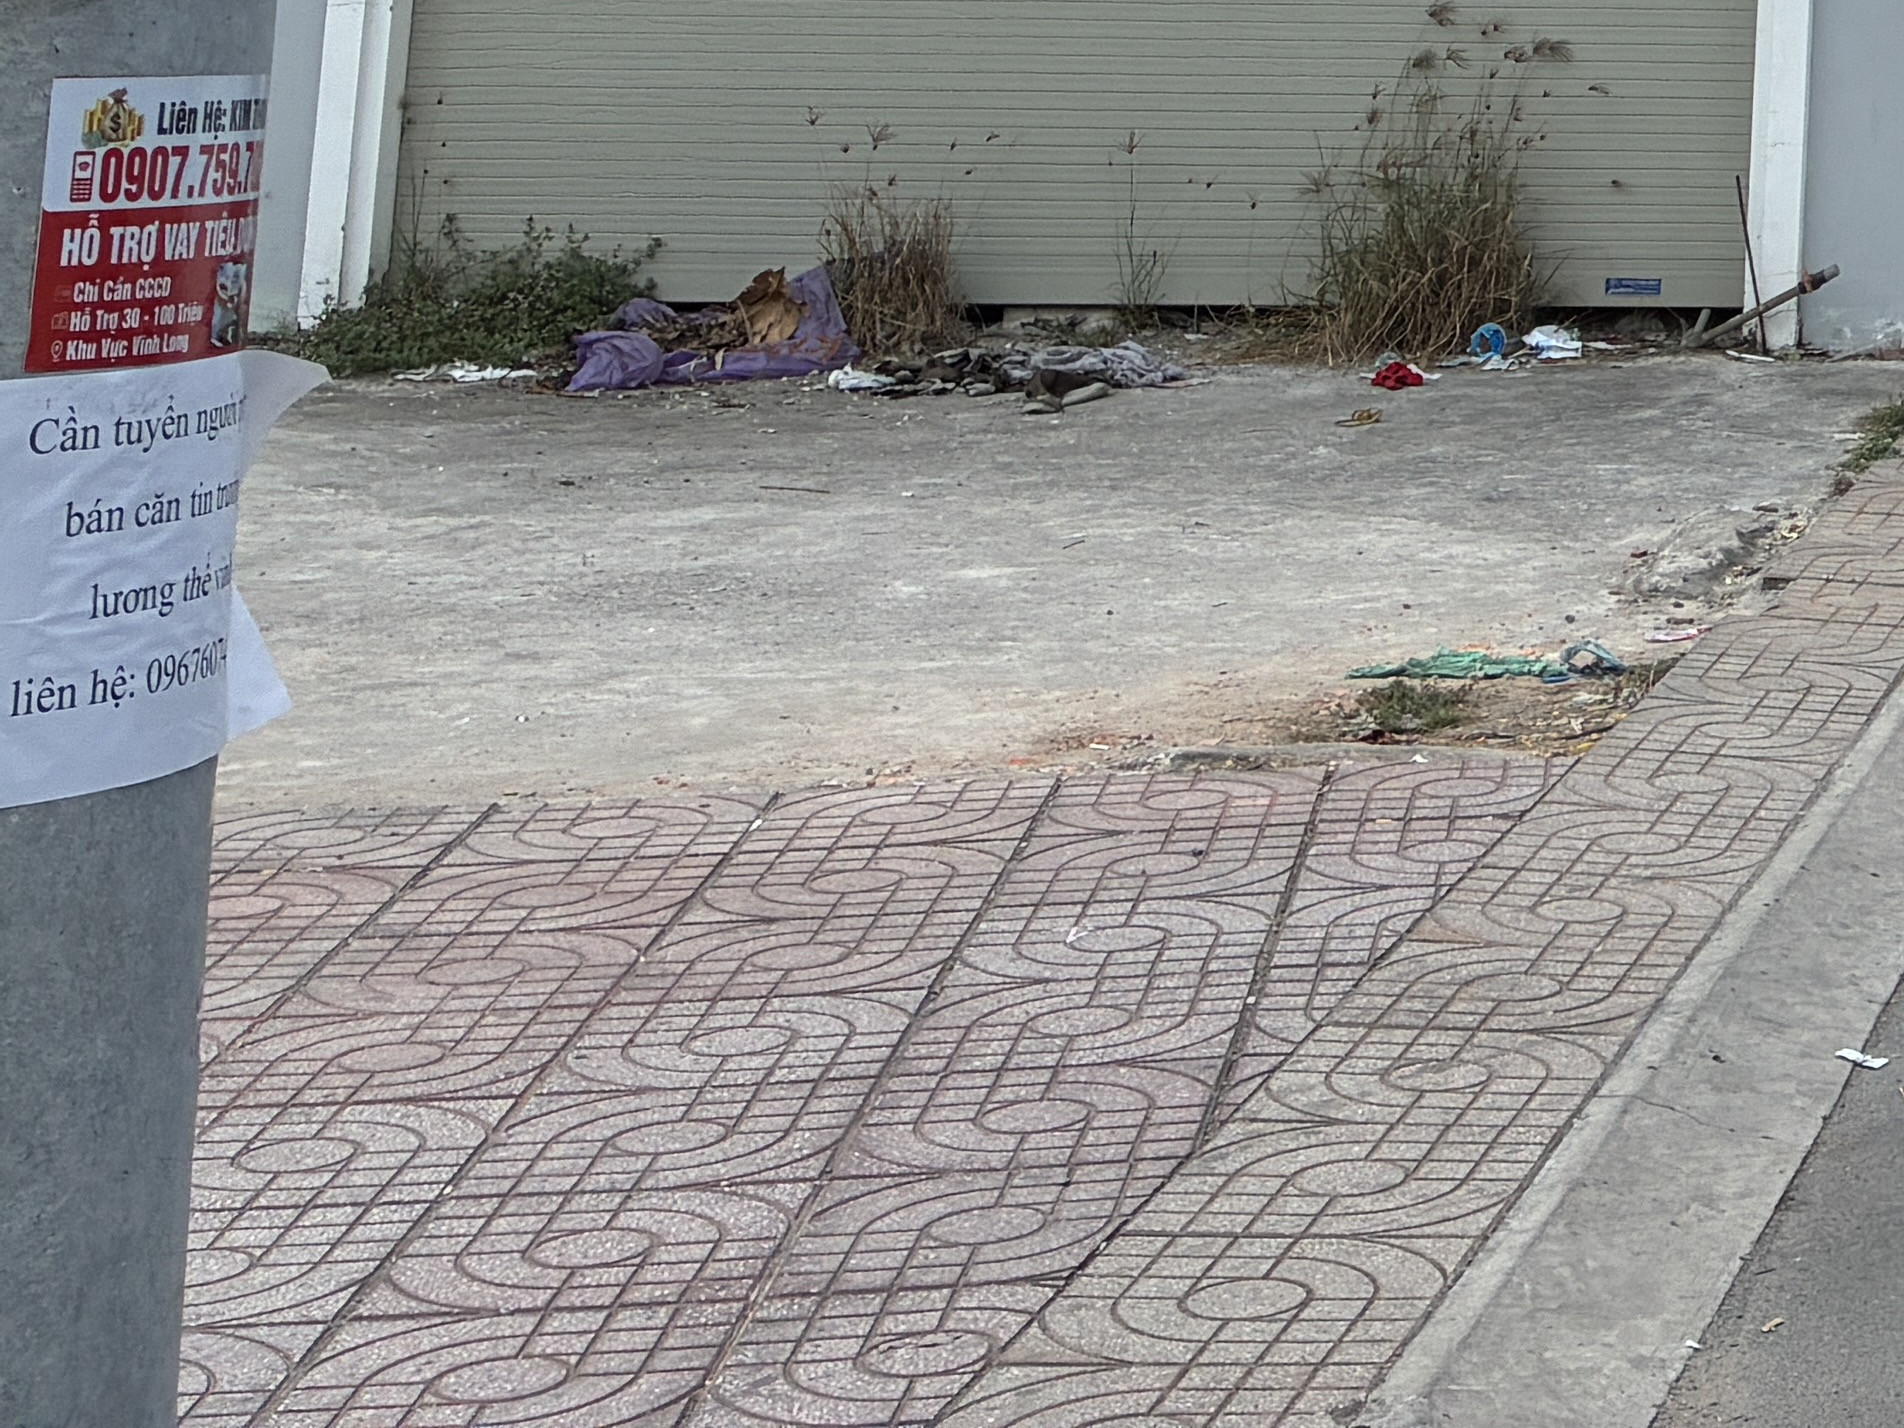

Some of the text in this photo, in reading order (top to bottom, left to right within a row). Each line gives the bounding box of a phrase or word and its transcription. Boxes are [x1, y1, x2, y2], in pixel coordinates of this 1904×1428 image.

[157, 101, 198, 135] Liên
[202, 100, 227, 140] Hệ:
[60, 213, 101, 267] HỖ
[110, 221, 159, 271] TRỢ
[164, 222, 201, 260] VAY
[121, 307, 140, 329] 30
[154, 304, 176, 326] 100
[66, 339, 97, 361] Khu
[101, 337, 128, 363] Vực
[29, 405, 100, 455] Cần
[113, 395, 190, 454] tuyển
[65, 498, 124, 537] bán
[134, 492, 181, 528] căn
[190, 482, 213, 518] tin
[90, 583, 176, 618] lương
[9, 676, 77, 717] liên
[89, 666, 136, 710] hệ:
